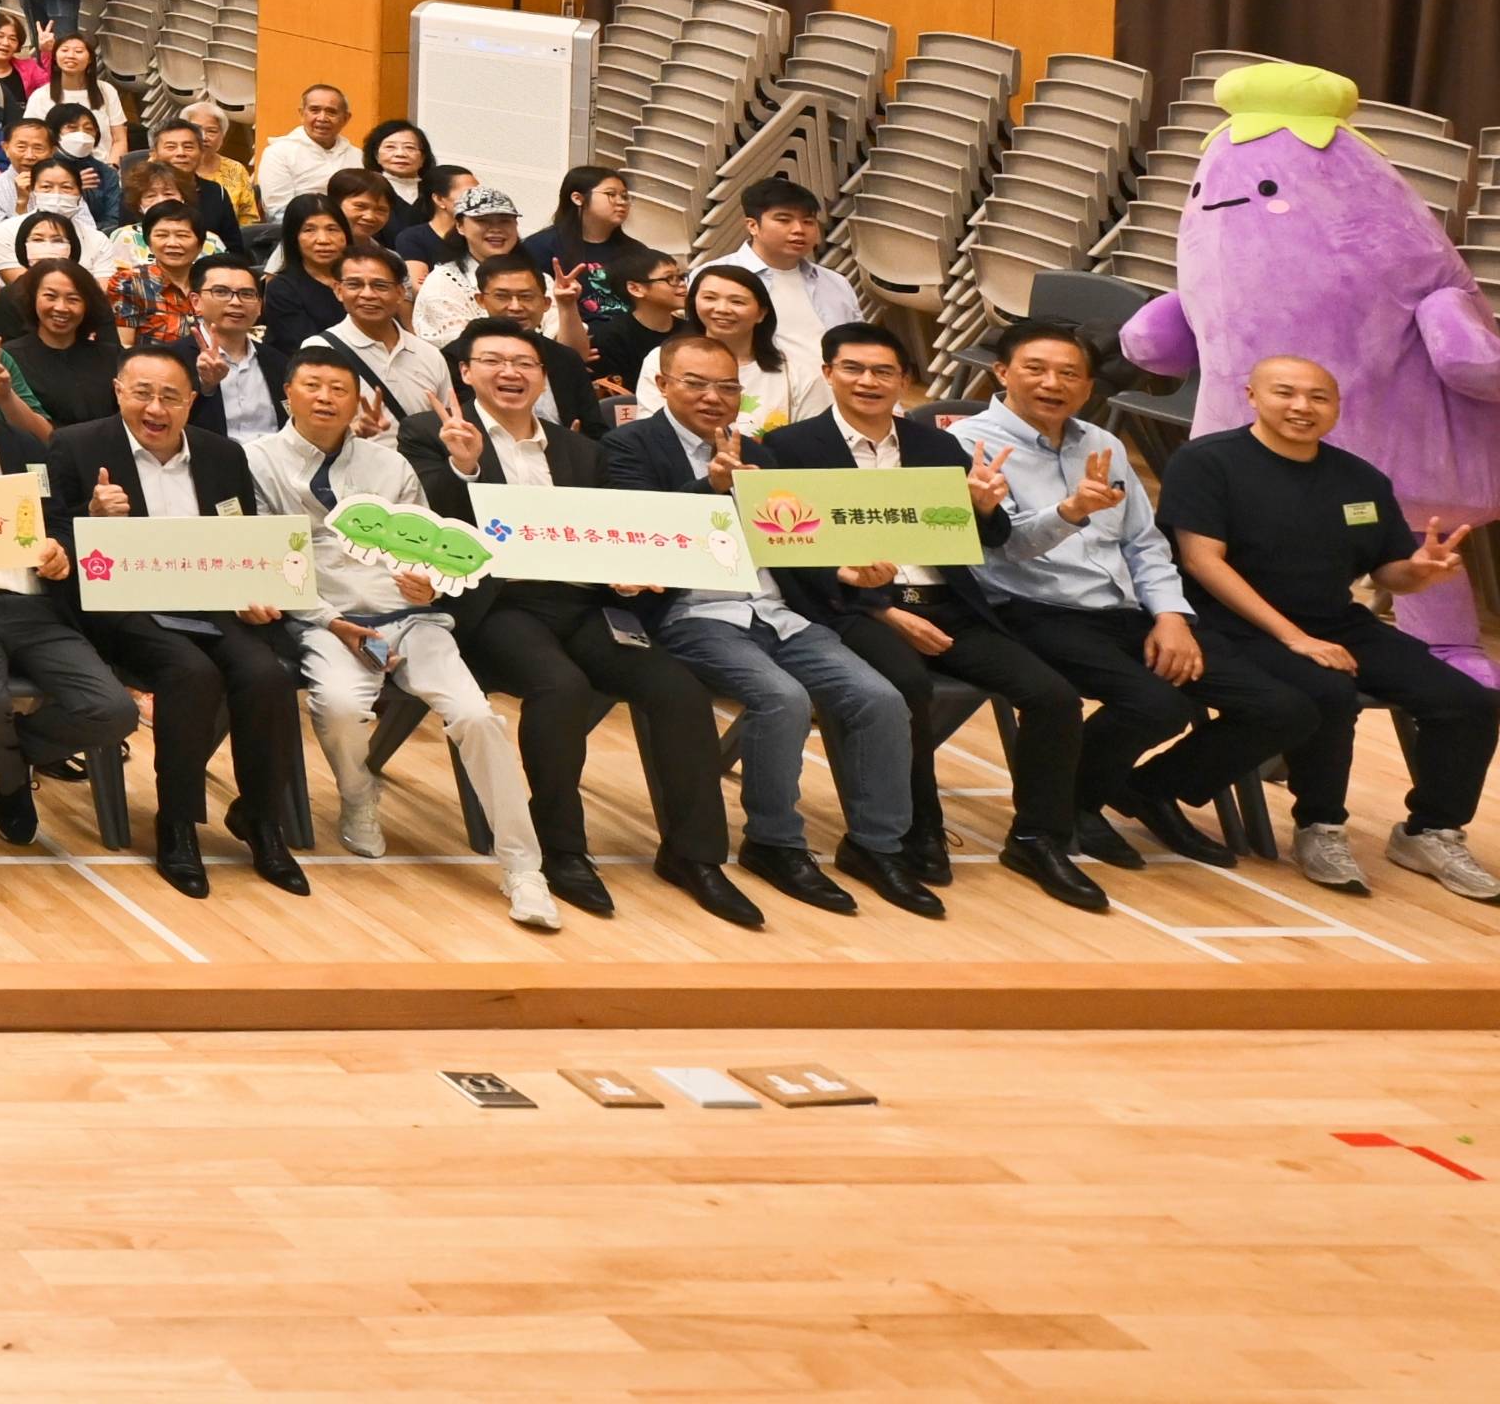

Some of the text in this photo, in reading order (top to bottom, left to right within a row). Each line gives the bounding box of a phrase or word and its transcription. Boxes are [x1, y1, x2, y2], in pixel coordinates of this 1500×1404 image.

[831, 507, 919, 525] 香港共修組
[519, 525, 692, 549] 香港島各界聯合會
